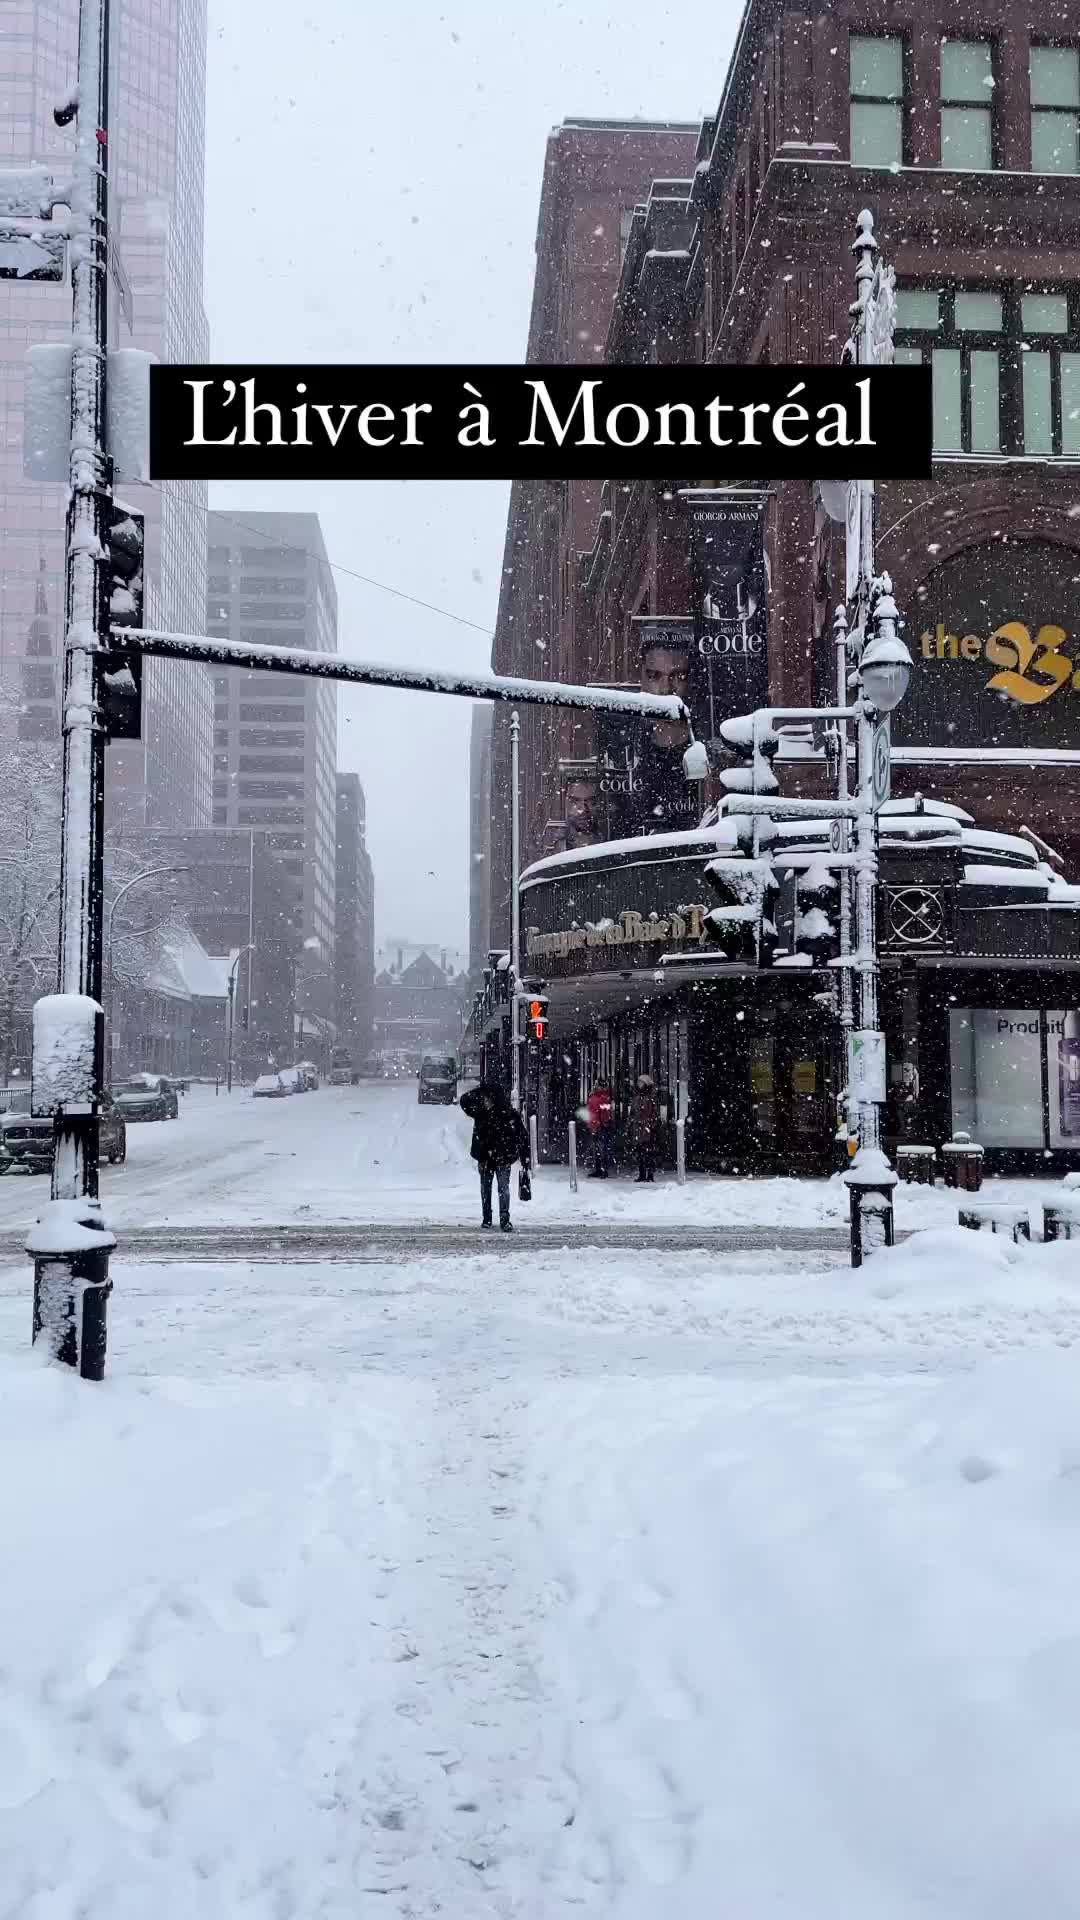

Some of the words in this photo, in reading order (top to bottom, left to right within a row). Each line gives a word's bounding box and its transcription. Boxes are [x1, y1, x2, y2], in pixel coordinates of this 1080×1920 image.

[693, 511, 727, 521] GIORGIO
[728, 511, 759, 521] ARMANI
[698, 630, 762, 654] code
[920, 623, 982, 660] the
[599, 774, 643, 792] code
[997, 1019, 1063, 1034] Prodit
